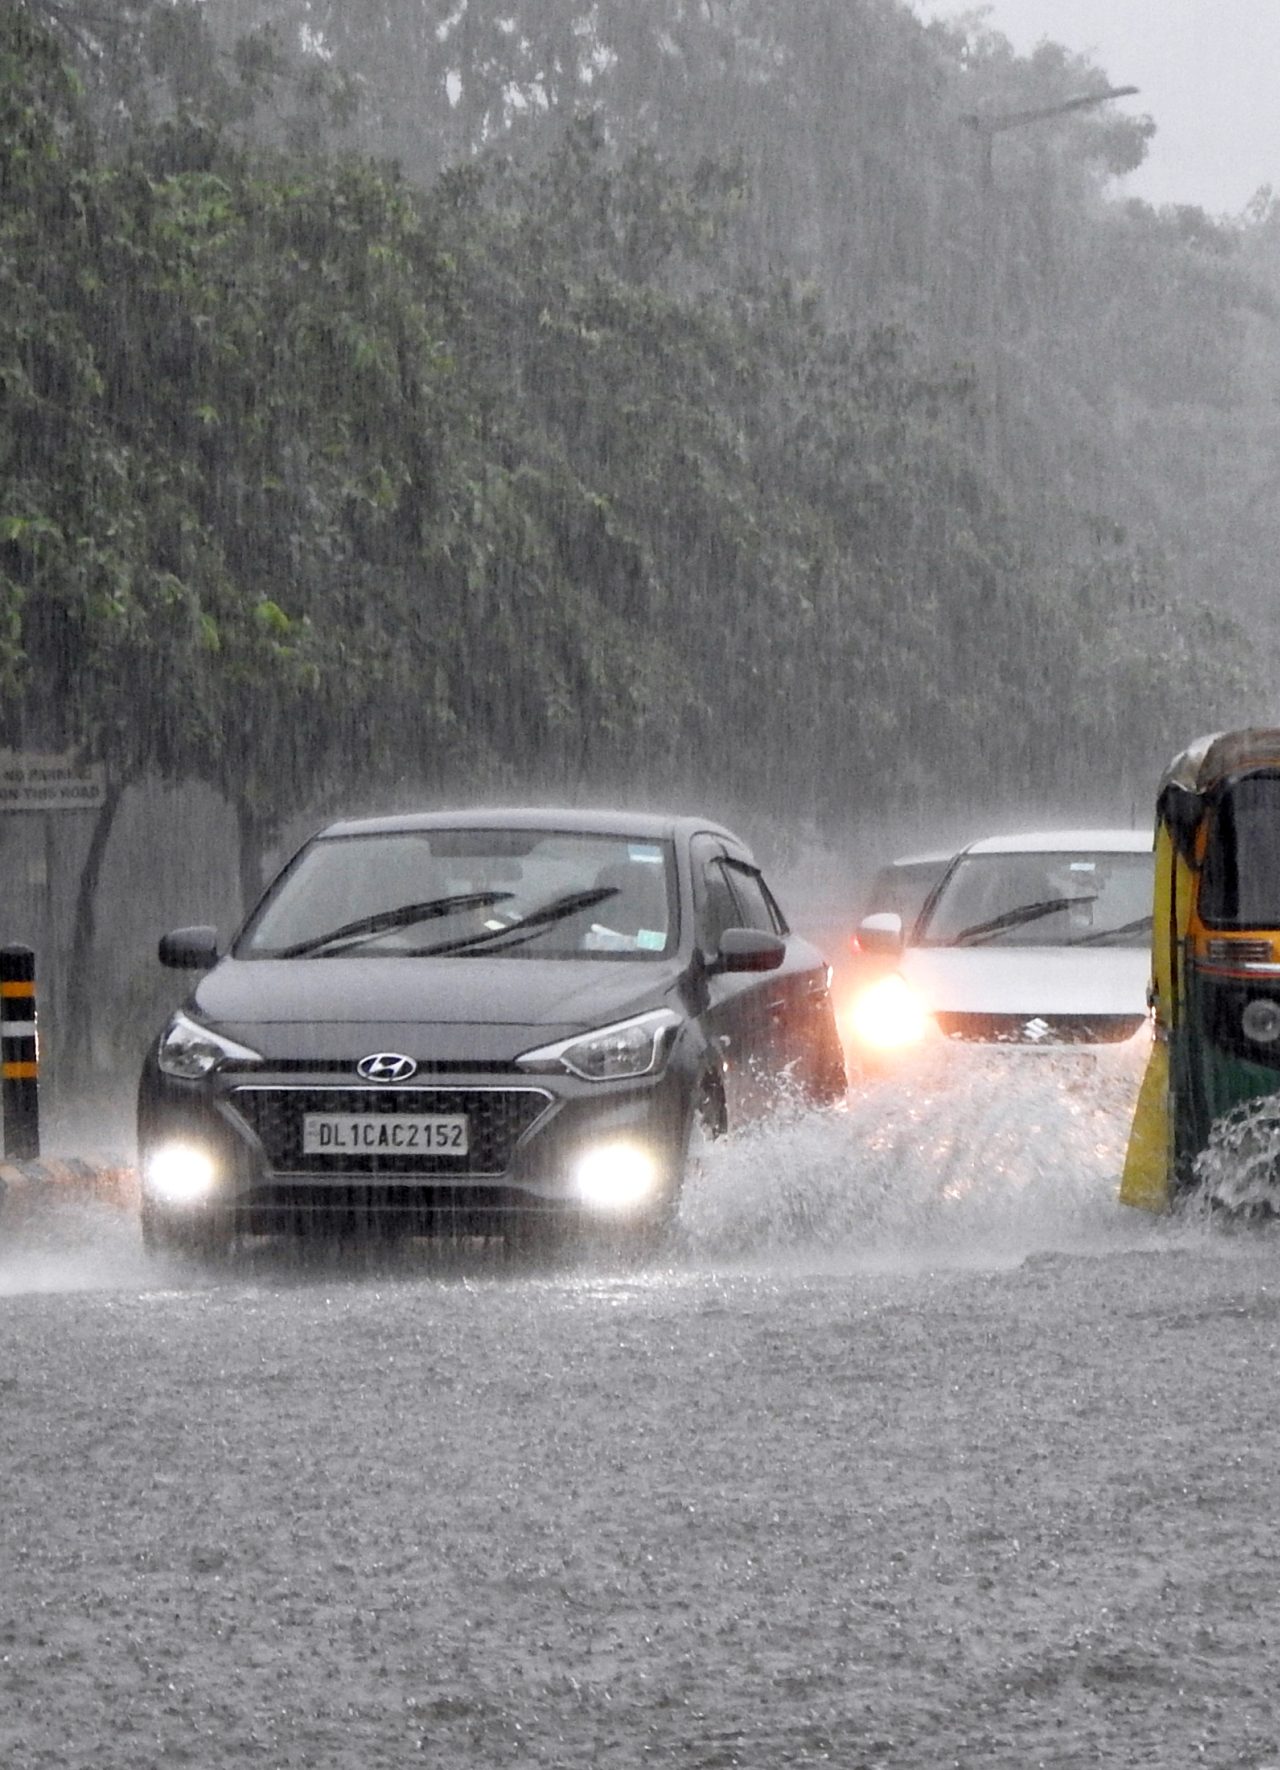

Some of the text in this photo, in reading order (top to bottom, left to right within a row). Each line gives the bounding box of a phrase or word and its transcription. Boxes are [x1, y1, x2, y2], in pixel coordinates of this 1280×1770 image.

[24, 787, 58, 800] THIS
[60, 785, 100, 799] ROAD
[319, 1122, 463, 1148] DL1CAC2152
